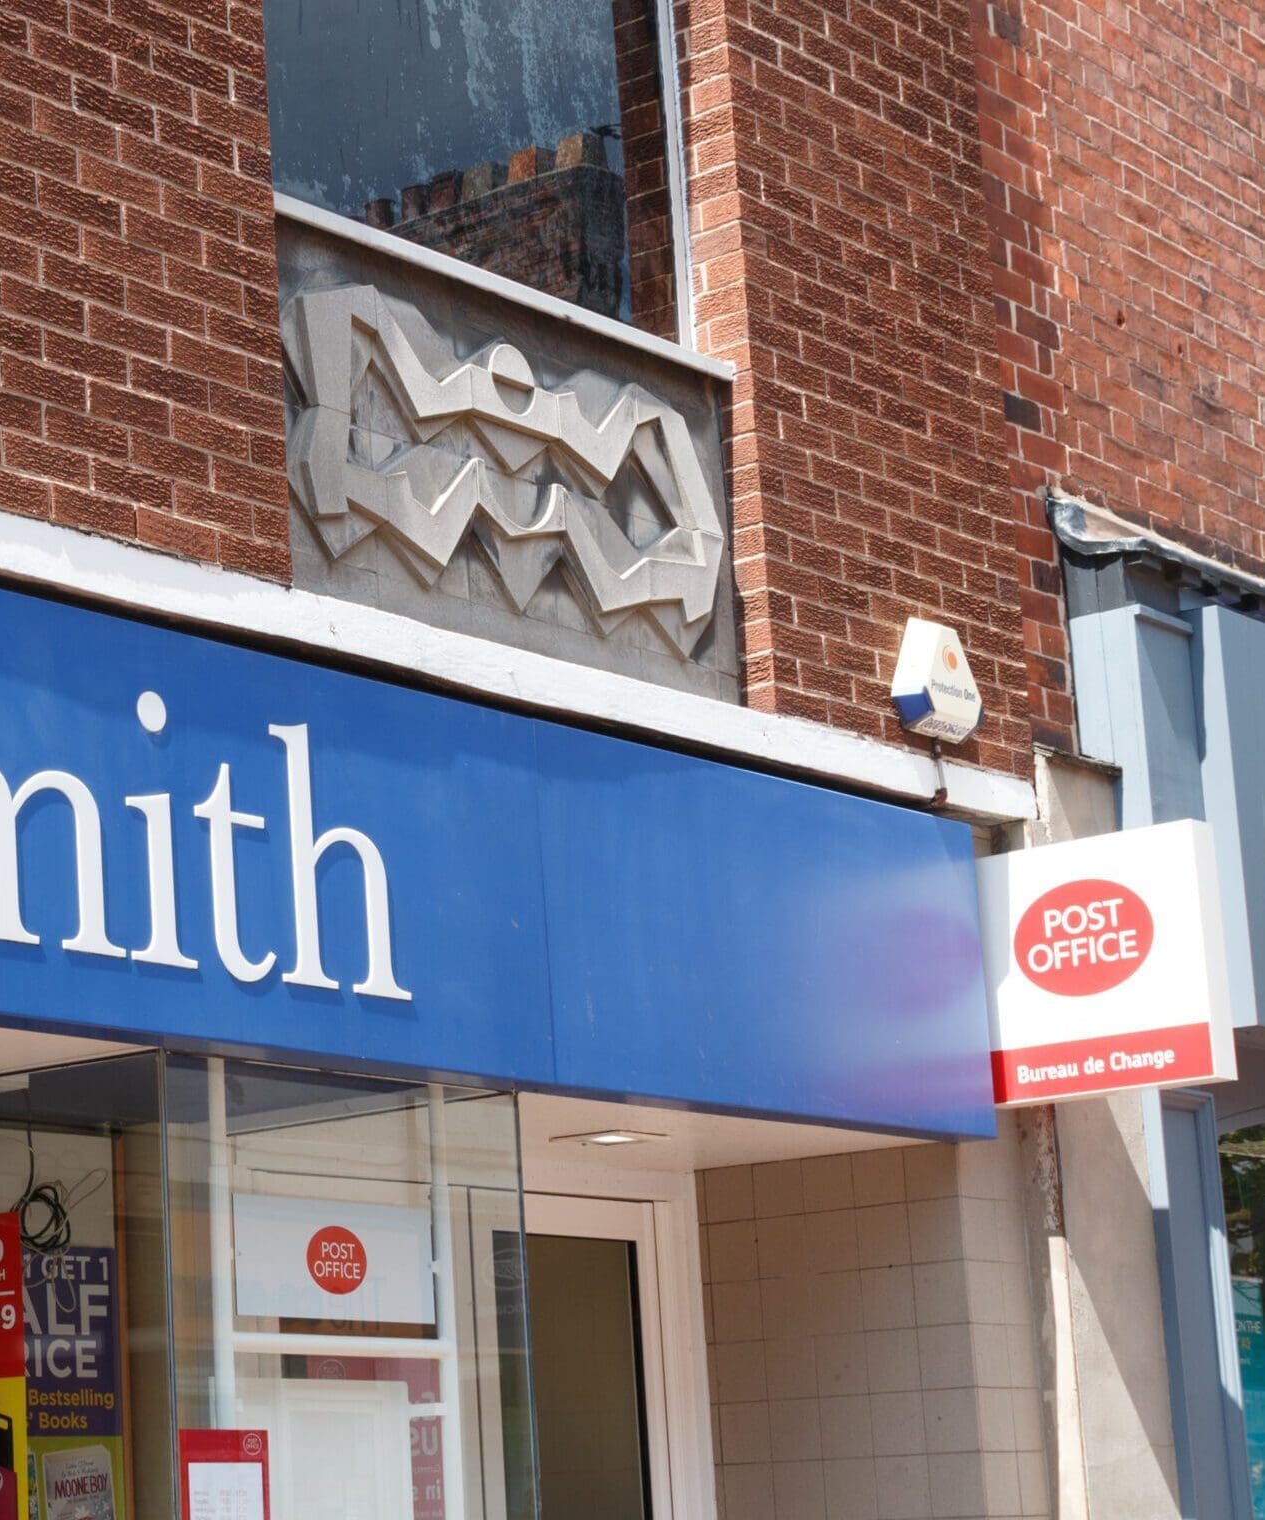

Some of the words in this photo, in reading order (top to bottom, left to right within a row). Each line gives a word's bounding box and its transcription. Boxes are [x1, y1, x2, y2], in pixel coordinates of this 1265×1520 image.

[1043, 897, 1124, 939] POST
[1027, 929, 1139, 974] OFFICE
[1016, 1063, 1079, 1084] Bureau
[1083, 1056, 1105, 1075] de
[1109, 1048, 1175, 1071] Change
[321, 1241, 355, 1260] POST
[40, 1255, 91, 1281] GET
[98, 1256, 109, 1282] 1
[313, 1260, 361, 1280] OFFICE
[28, 1388, 115, 1410] Bestselling
[38, 1412, 88, 1429] Books
